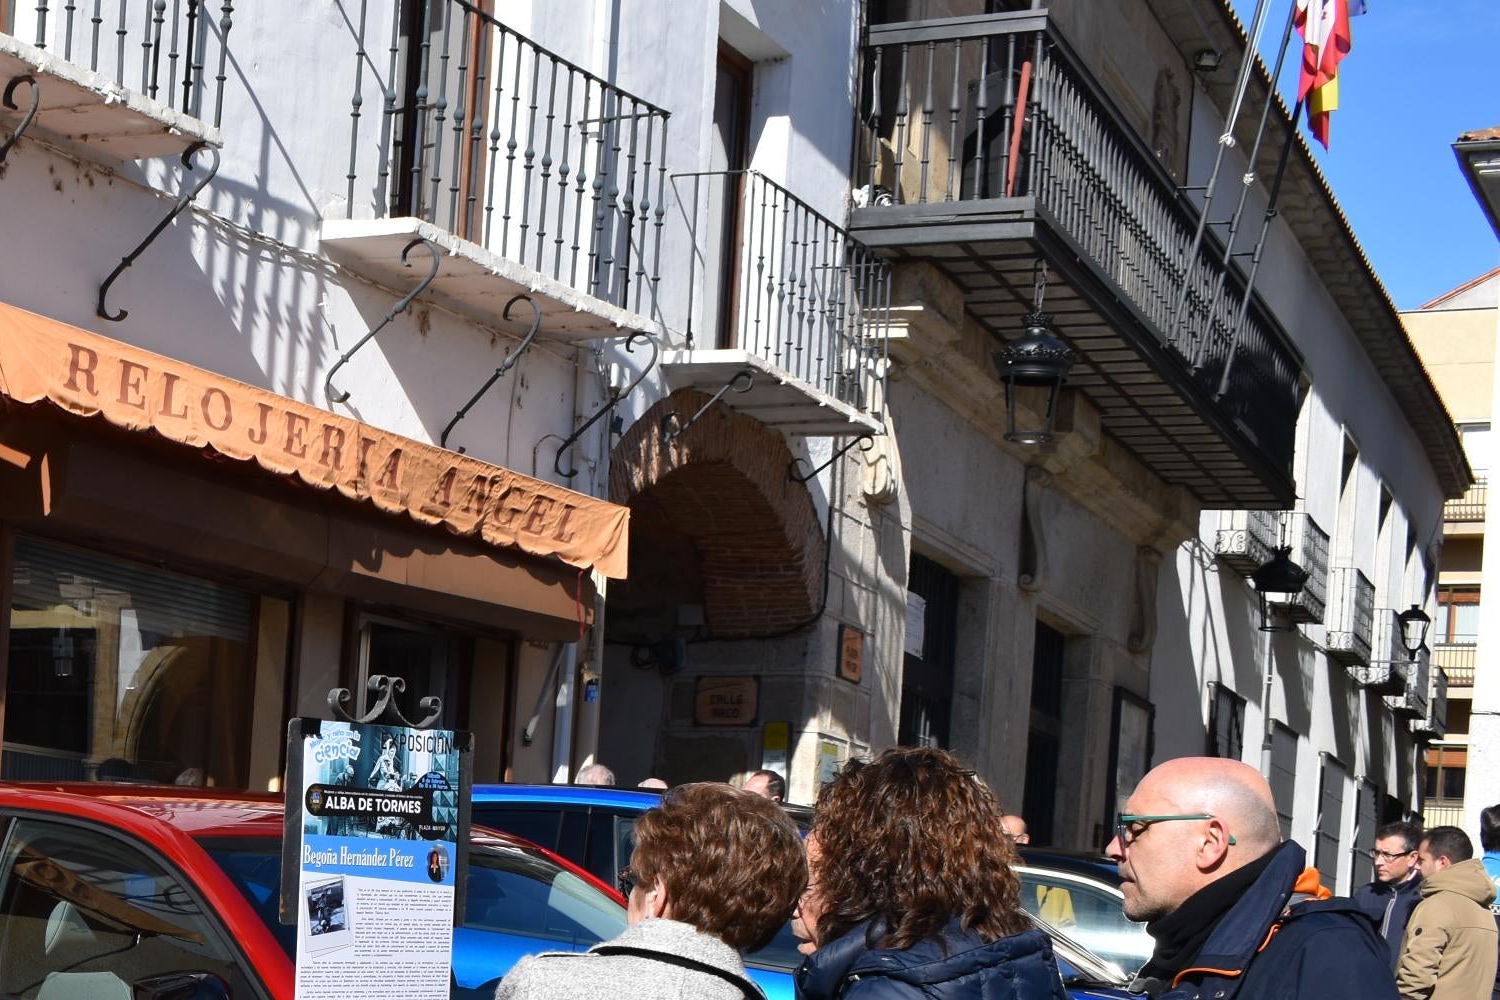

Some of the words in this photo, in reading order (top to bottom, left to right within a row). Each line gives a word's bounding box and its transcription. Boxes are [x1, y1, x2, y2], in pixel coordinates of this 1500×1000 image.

[61, 342, 405, 489] RELOJERIA
[422, 466, 576, 544] ANGEL
[315, 741, 360, 764] ciencia
[325, 796, 355, 810] ALBA
[358, 797, 375, 811] DE
[376, 798, 421, 814] TORMES
[304, 844, 337, 868] Begoña
[340, 844, 387, 867] Hernández
[389, 848, 414, 868] Pérez
